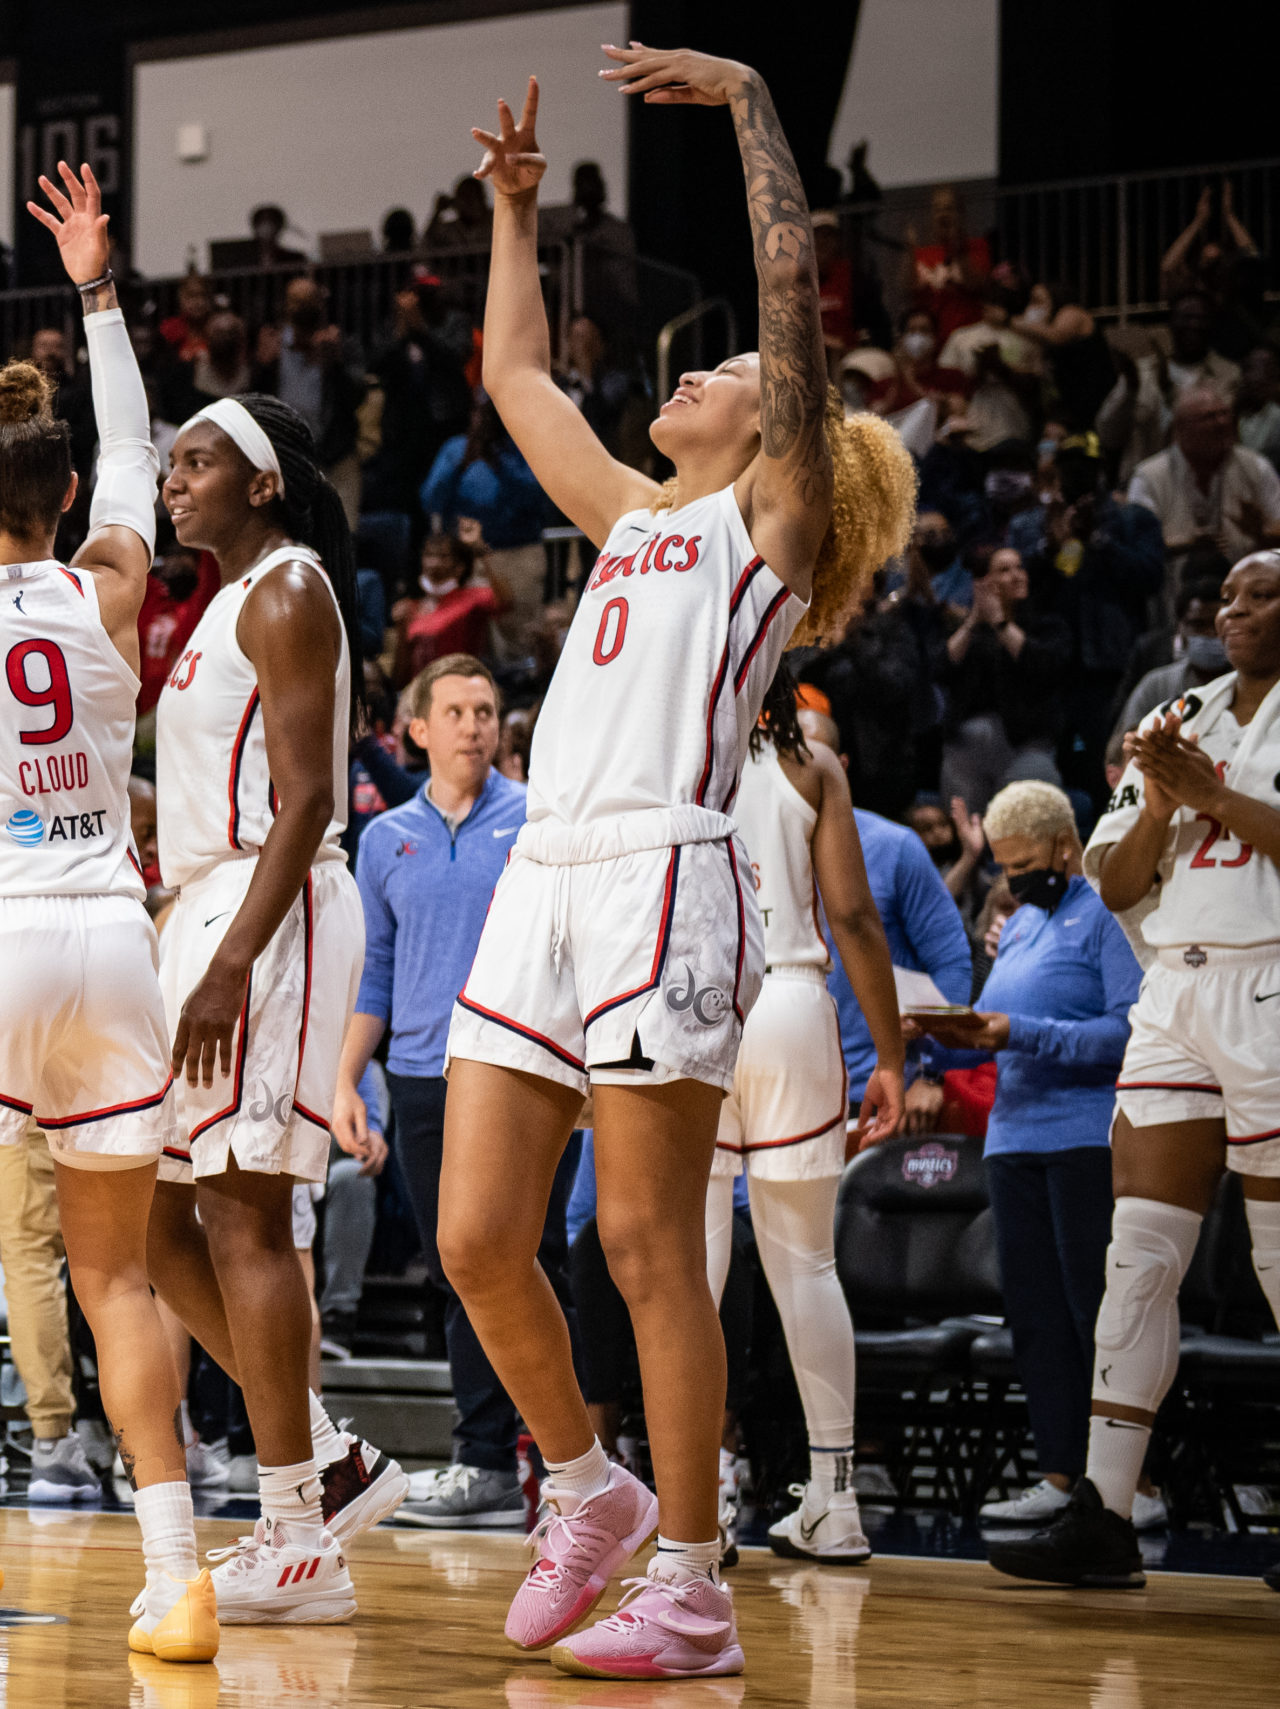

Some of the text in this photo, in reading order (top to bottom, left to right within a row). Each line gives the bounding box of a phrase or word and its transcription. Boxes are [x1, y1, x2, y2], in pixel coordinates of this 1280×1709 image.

[22, 116, 118, 200] 106
[593, 596, 629, 666] 0
[5, 638, 74, 745] 9
[18, 752, 89, 796] CLOUD
[49, 809, 107, 842] AT&T
